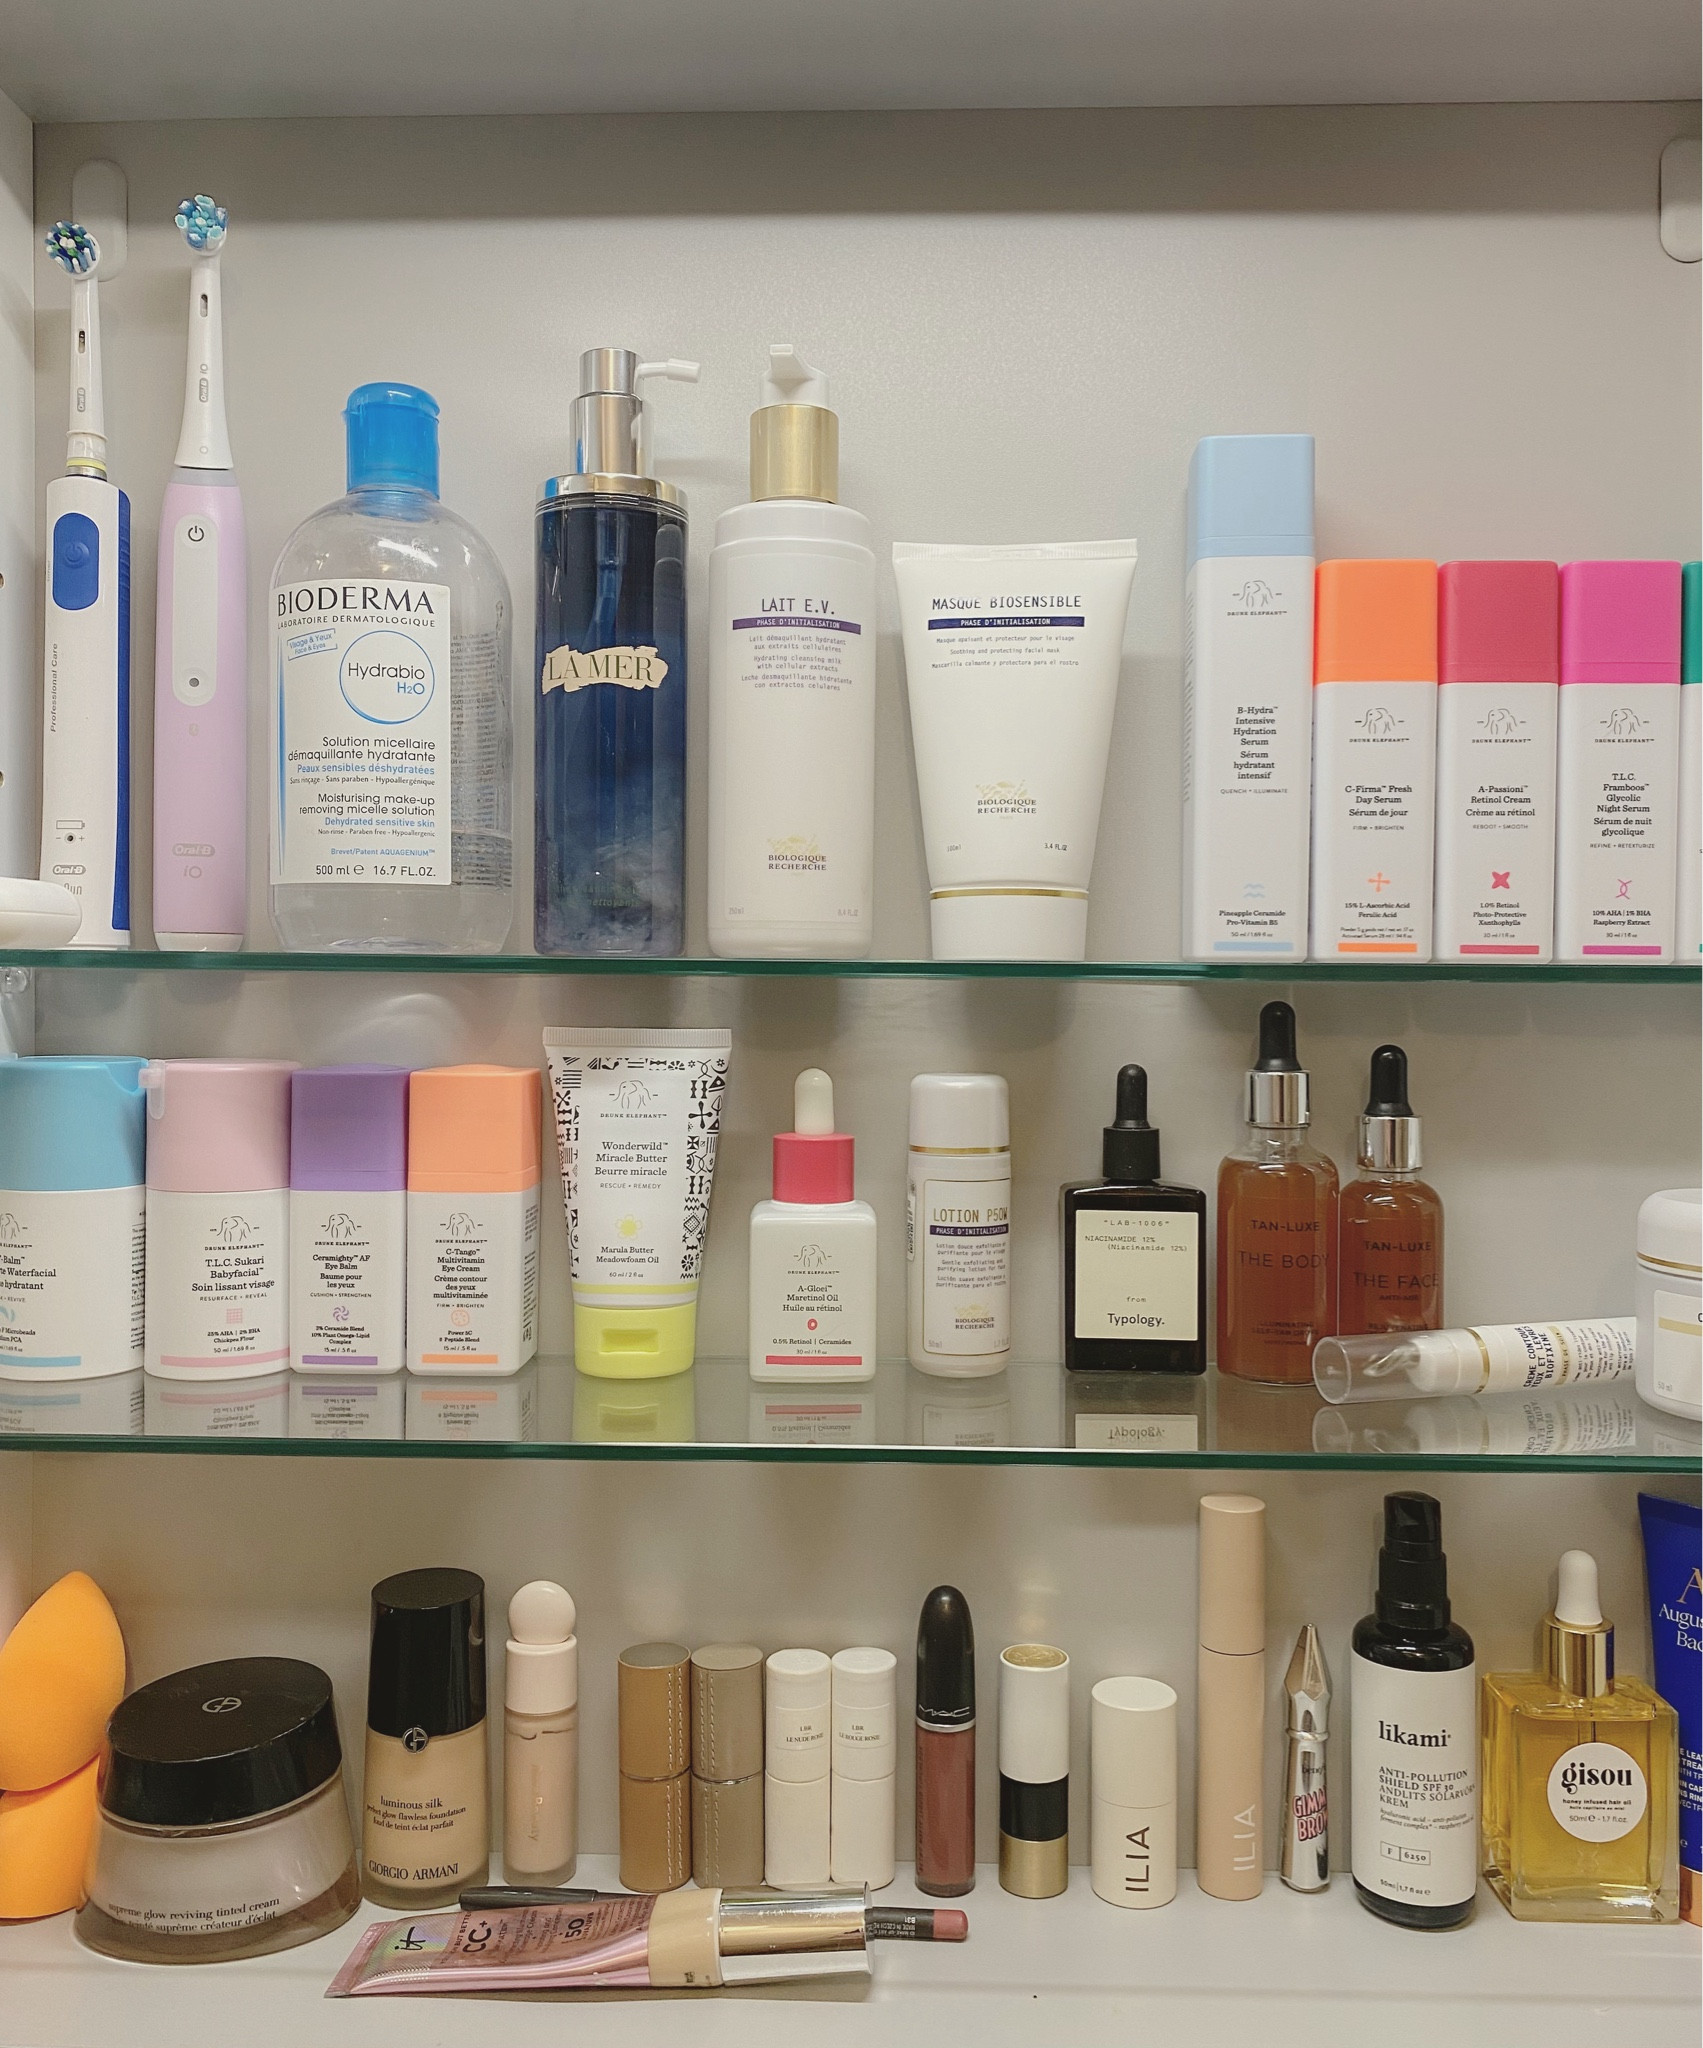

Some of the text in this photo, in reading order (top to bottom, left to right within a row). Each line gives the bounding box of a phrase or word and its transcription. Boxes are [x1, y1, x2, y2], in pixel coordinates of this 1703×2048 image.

[278, 586, 435, 616] BIODERMA
[761, 597, 835, 615] LAIT E.V.
[932, 595, 1082, 610] MASQUE BIOSENSIBLE
[278, 615, 435, 629] LABORATOIRE DERMATOLOGIQUE
[779, 619, 840, 629] D'INITIALISATION
[348, 663, 425, 680] Hydrabio
[548, 654, 654, 682] LA MER
[50, 669, 58, 733] Professional
[1235, 717, 1275, 725] Intensive
[1233, 727, 1277, 736] Hydration
[322, 737, 435, 750] Solution micellaire
[1240, 738, 1269, 746] Serum
[288, 749, 435, 763] démaquillante hydratante
[1240, 750, 1269, 759] Sérum
[297, 763, 435, 775] Peaux sensibles déshydratées
[1233, 761, 1275, 770] hydratant
[1237, 771, 1272, 779] intensif
[1612, 773, 1636, 781] T.L.C.
[1388, 785, 1413, 793] Fresh
[318, 793, 435, 806] Moisturising make-up
[977, 798, 1037, 806] BIOLOGIQUE
[1355, 796, 1402, 805] Day Serum
[1471, 796, 1531, 804] Retinol Cream
[1606, 794, 1641, 803] Glycolic
[300, 804, 435, 816] removing micelle solution
[1349, 809, 1377, 817] Sérum
[1390, 809, 1408, 818] jour
[1466, 808, 1494, 816] Crème
[1507, 808, 1535, 816] rétinol
[1596, 805, 1650, 814] Night Serum
[325, 817, 435, 828] Dehydrated sensitive skin
[1593, 817, 1622, 825] Sérum
[1601, 828, 1645, 837] glycolique
[54, 866, 83, 874] Oral-B
[316, 865, 350, 875] 500 ml
[374, 866, 436, 877] 16.7 FL.OZ.
[596, 1154, 668, 1163] Miracle Butter
[594, 1167, 668, 1176] Beurre miracle
[933, 1208, 979, 1223] LOTION
[1251, 1219, 1320, 1232] TAN-LUXE
[1085, 1235, 1136, 1243] NIACINAMIDE
[1363, 1240, 1432, 1251] TAN-LUXE
[205, 1256, 265, 1267] T.L.C. Sukari
[359, 1254, 371, 1262] AF
[437, 1256, 485, 1264] Multivitamin
[1239, 1251, 1329, 1269] THE BODY
[324, 1262, 358, 1271] Eye Balm
[441, 1265, 454, 1273] Eye
[7, 1268, 56, 1277] Waterfacial
[320, 1273, 362, 1282] Baume pour
[434, 1275, 487, 1283] Crème contour
[1353, 1272, 1439, 1289] THE FACE
[4, 1281, 44, 1291] hydratant
[191, 1278, 275, 1292] Soin lissant visage
[338, 1282, 355, 1290] yeux
[433, 1291, 488, 1299] multivitaminée
[787, 1294, 839, 1302] Maretinol Oil
[816, 1304, 843, 1312] rétinol
[1107, 1313, 1165, 1327] Typology.
[1523, 1364, 1536, 1387] CREME
[1379, 1766, 1468, 1783] ANTI-POLLUTION
[1561, 1762, 1632, 1795] gisou
[1379, 1775, 1454, 1793] SHIELD SPF 30
[380, 1795, 443, 1809] luminous silk
[1379, 1794, 1409, 1808] KREM
[1233, 1804, 1255, 1871] ILIA
[1125, 1826, 1150, 1892] ILIA
[1404, 1851, 1427, 1861] 6250
[369, 1860, 459, 1880] GIORGIO ARMANI
[144, 1898, 280, 1921] glow reviving tinted cream
